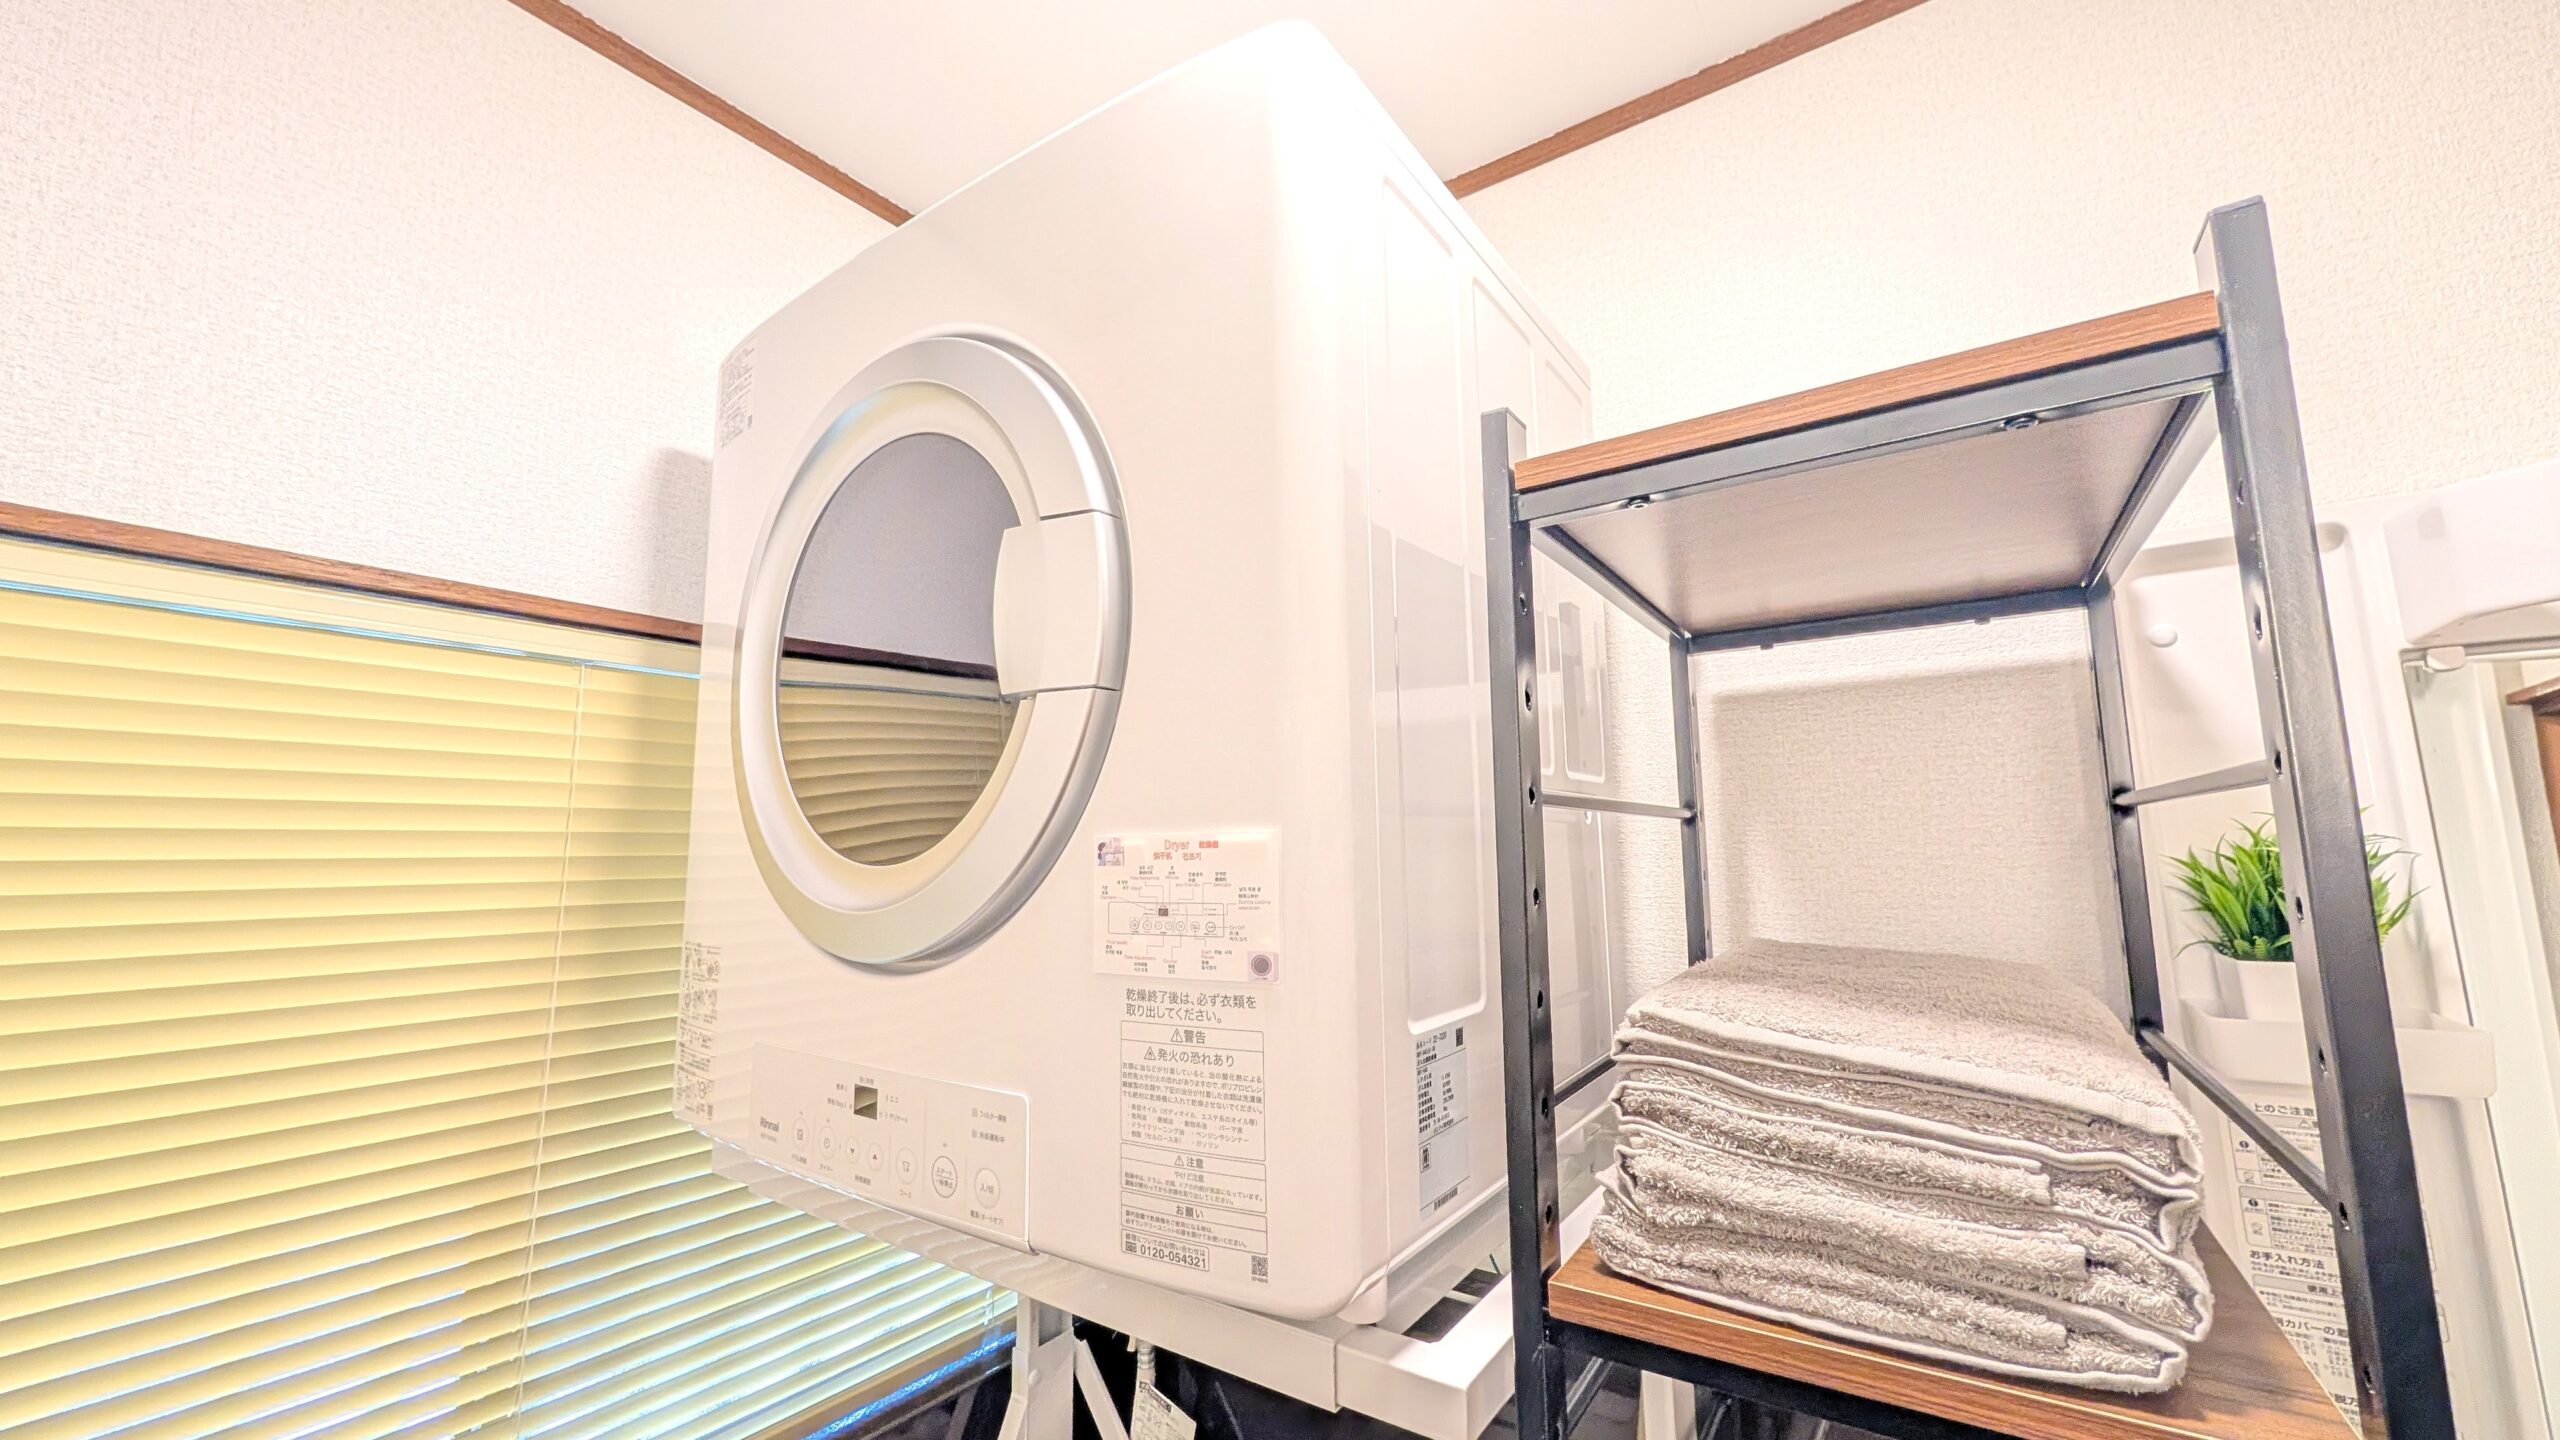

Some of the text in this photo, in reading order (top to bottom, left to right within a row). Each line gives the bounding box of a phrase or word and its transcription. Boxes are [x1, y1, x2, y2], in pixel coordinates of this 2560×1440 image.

[1126, 988, 1256, 1009] 乾燥終了後は、必ず衣類を
[1126, 1003, 1222, 1024] 取り出してください。
[1183, 1029, 1206, 1044] 警告
[1157, 1048, 1235, 1067] 発火の恐れあり
[759, 1115, 780, 1133] Rinnai
[1186, 1156, 1205, 1169] 注意
[1175, 1204, 1205, 1219] お願い
[1140, 1245, 1206, 1269] 0120-054321
[2249, 1250, 2325, 1270] お手入れ方法
